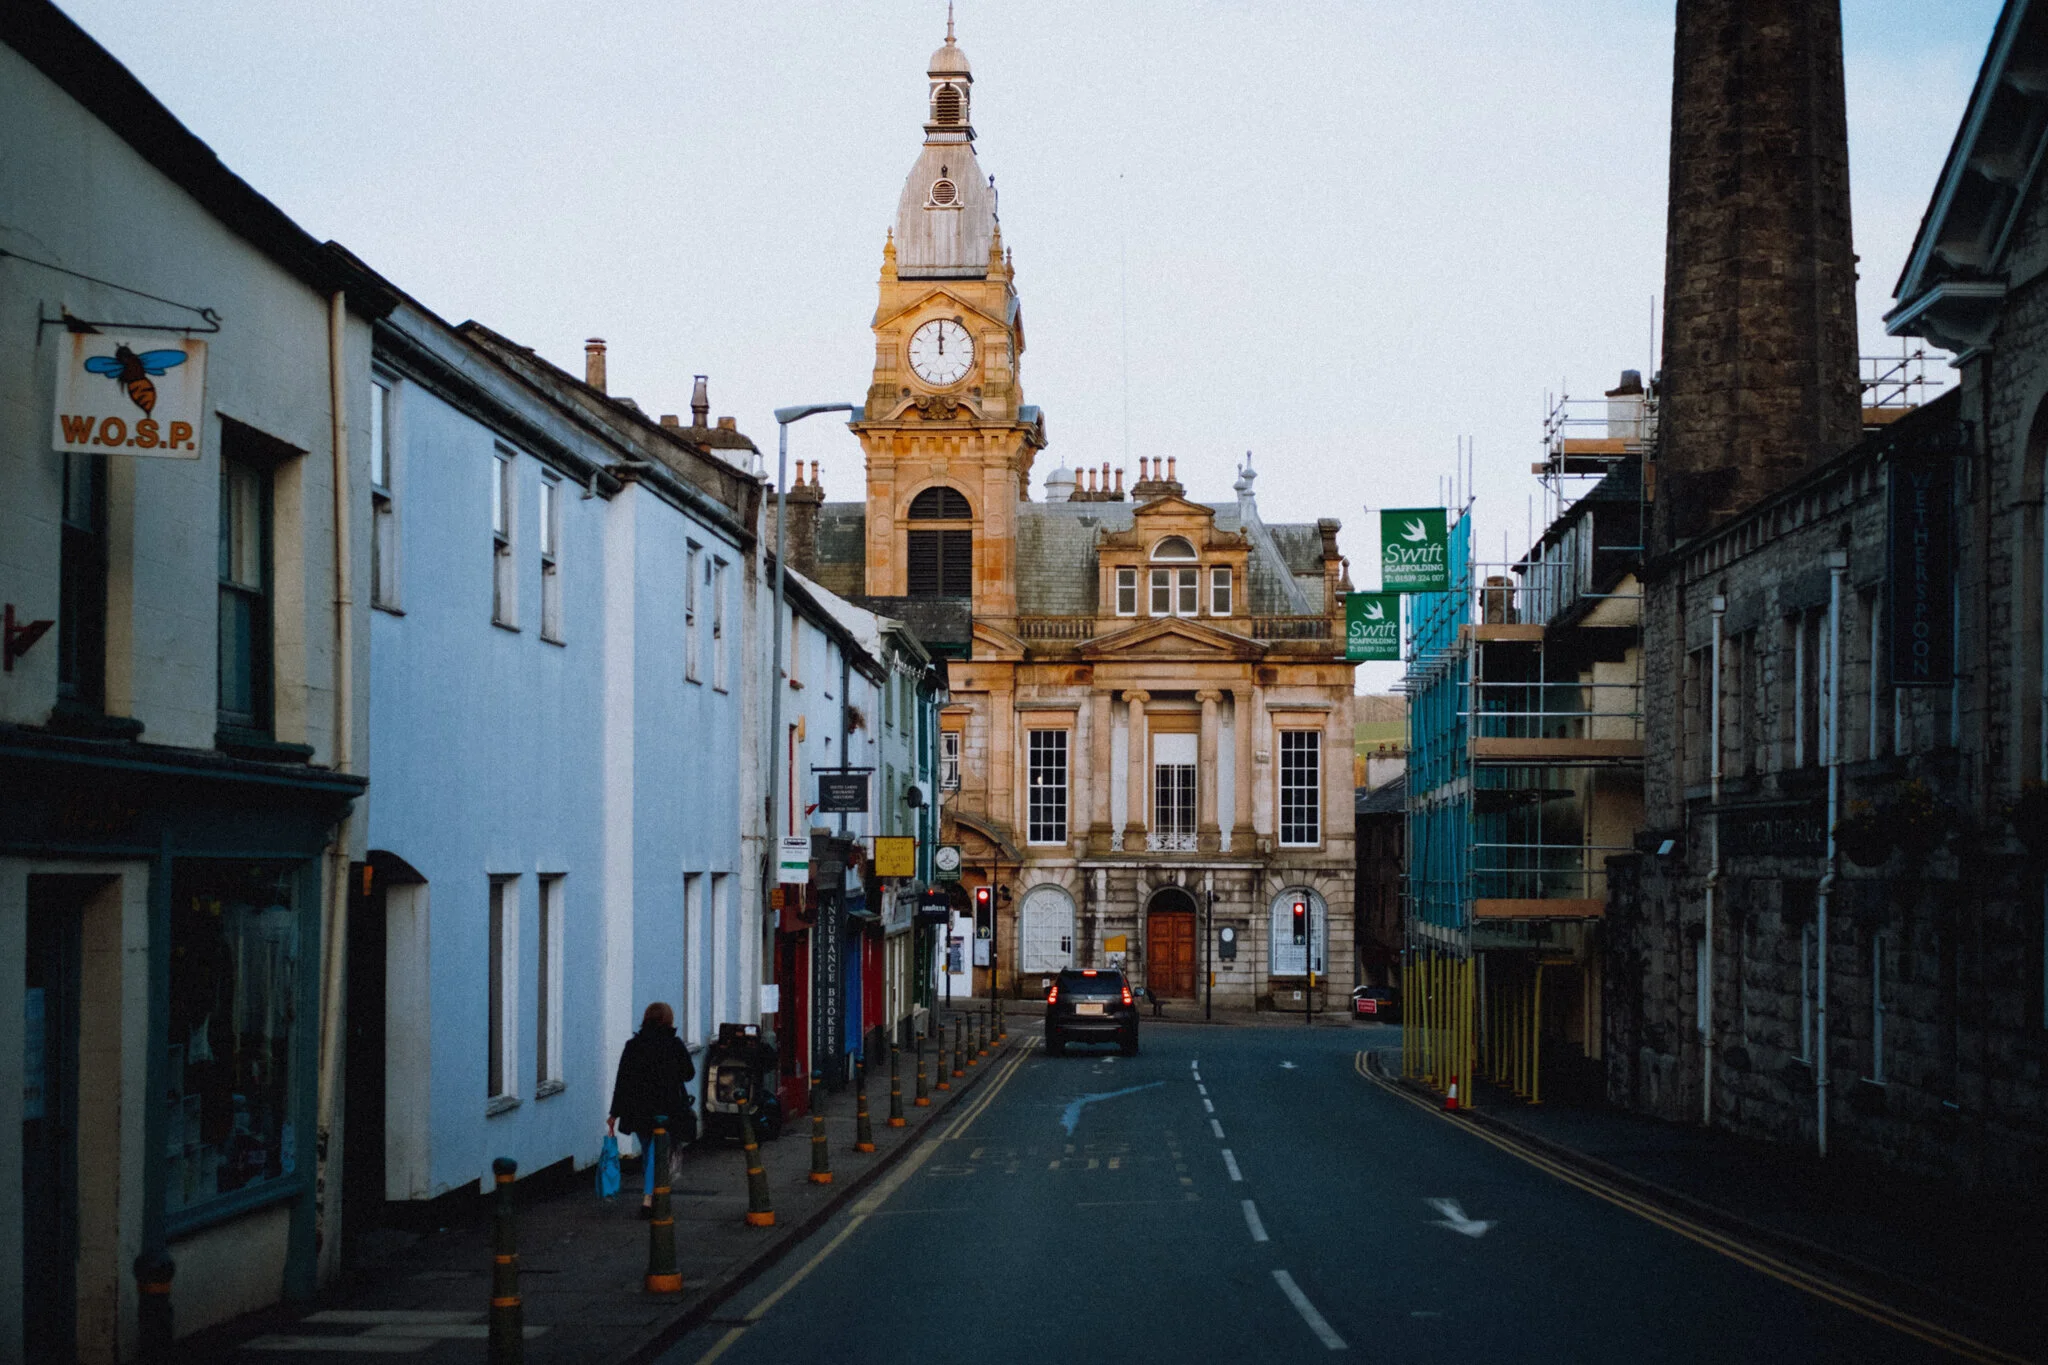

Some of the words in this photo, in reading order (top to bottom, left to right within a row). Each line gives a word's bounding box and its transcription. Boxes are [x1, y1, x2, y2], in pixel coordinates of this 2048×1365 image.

[60, 415, 195, 450] W.O.S.P.
[1385, 543, 1443, 563] Swift
[1385, 564, 1443, 572] SCAFFOLDING
[1911, 472, 1932, 676] WETHERSPOON
[1349, 621, 1397, 636] Swift
[827, 896, 836, 983] INSURANCE
[827, 988, 836, 1055] BROKERS
